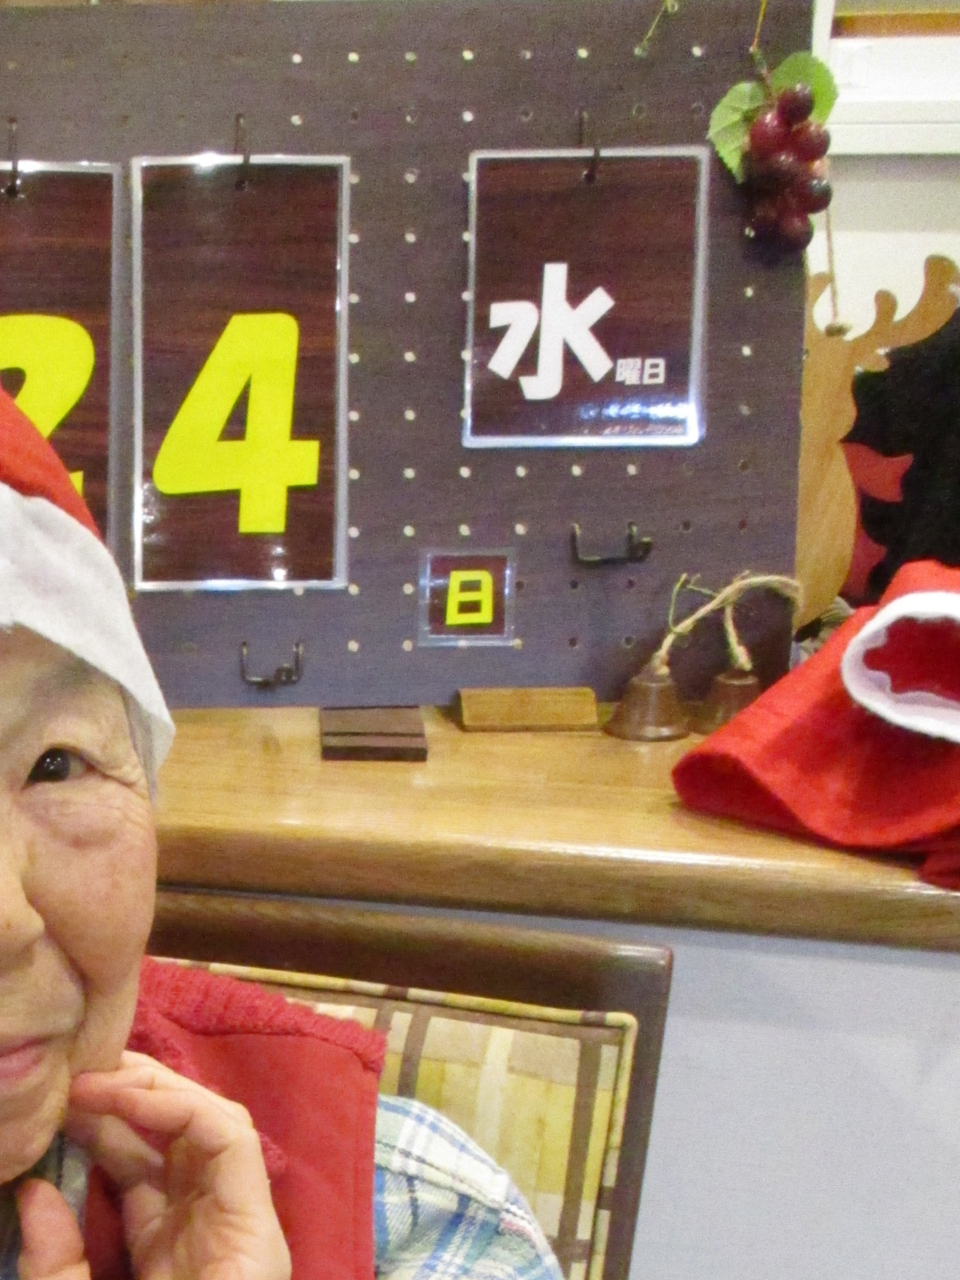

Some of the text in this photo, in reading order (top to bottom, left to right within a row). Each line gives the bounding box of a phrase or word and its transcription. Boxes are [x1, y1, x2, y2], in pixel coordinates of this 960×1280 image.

[487, 263, 666, 400] 水曜日
[152, 312, 321, 534] 4
[445, 569, 494, 626] 日
